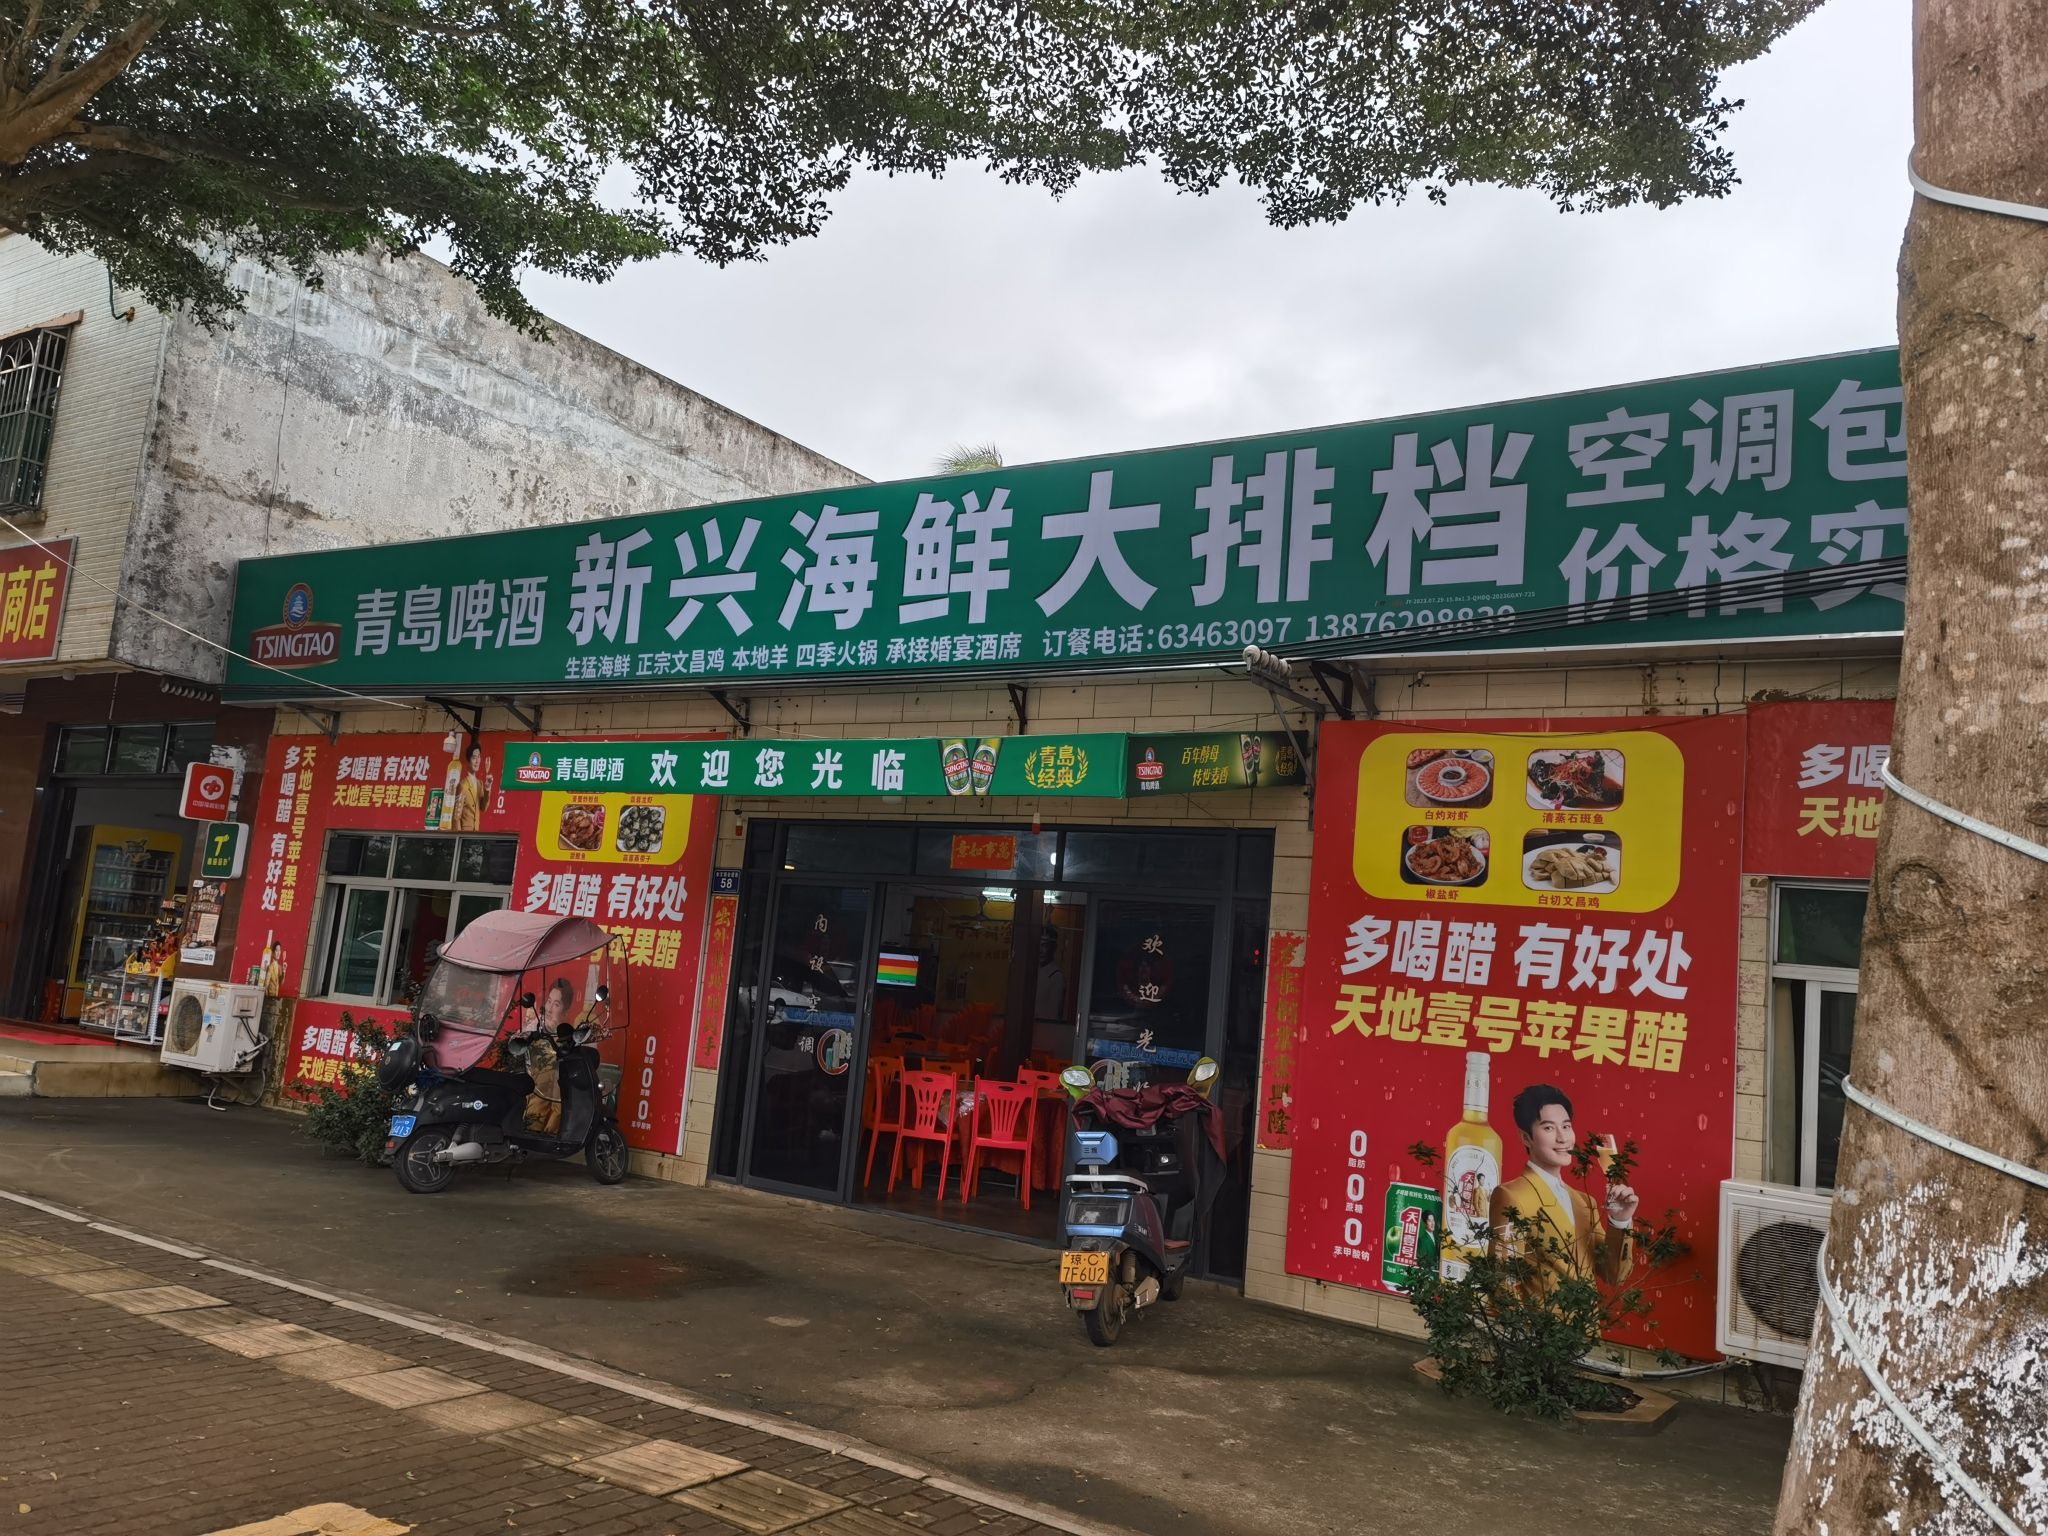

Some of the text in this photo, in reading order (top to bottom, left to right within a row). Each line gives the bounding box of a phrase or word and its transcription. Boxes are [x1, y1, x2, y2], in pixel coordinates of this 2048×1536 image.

[567, 423, 1535, 646] 新兴海鲜大排档
[0, 560, 57, 643] 商店
[254, 630, 335, 660] TSINGTAO
[565, 655, 630, 680] 生猛海鲜
[636, 647, 725, 676] 正宗文昌鸡
[731, 643, 789, 671] 本地羊
[796, 638, 878, 668] 四季火锅
[885, 631, 1023, 664] 承接婚宴酒席
[1181, 745, 1219, 765] 百年酵母
[336, 755, 430, 781] 多喝醋 有好处
[518, 769, 551, 780] TSINGTAO
[1037, 767, 1075, 789] 经典
[1137, 765, 1163, 776] TSINGTAO
[1192, 767, 1229, 787] 传世麦香
[332, 784, 426, 808] 天地壹号苹果醋
[1425, 810, 1469, 821] 白灼对虾
[1542, 812, 1604, 824] 清蒸石斑鱼
[261, 745, 301, 912] 多喝醋 有好处
[278, 745, 317, 912] 天地壹号苹果醋
[720, 877, 733, 889] 58
[524, 871, 688, 922] 多喝醋 有好处
[1425, 888, 1459, 900] 椒盐虾
[1538, 894, 1600, 908] 白切文昌鸡
[1340, 914, 1693, 1000] 多喝醋 有好处
[1331, 983, 1688, 1073] 天地壹号苹果醋
[301, 1025, 348, 1056] 多喝醋
[645, 1035, 657, 1056] 0
[641, 1067, 653, 1088] 0
[637, 1099, 649, 1120] 0
[1349, 1130, 1367, 1157] 0
[1348, 1158, 1366, 1168] 脂肪
[1347, 1174, 1365, 1201] 0
[1345, 1202, 1363, 1214] 蔗糖
[1344, 1218, 1362, 1246] 0
[1334, 1245, 1370, 1261] 苯甲酸钠
[1063, 1266, 1105, 1282] 7F6U2
